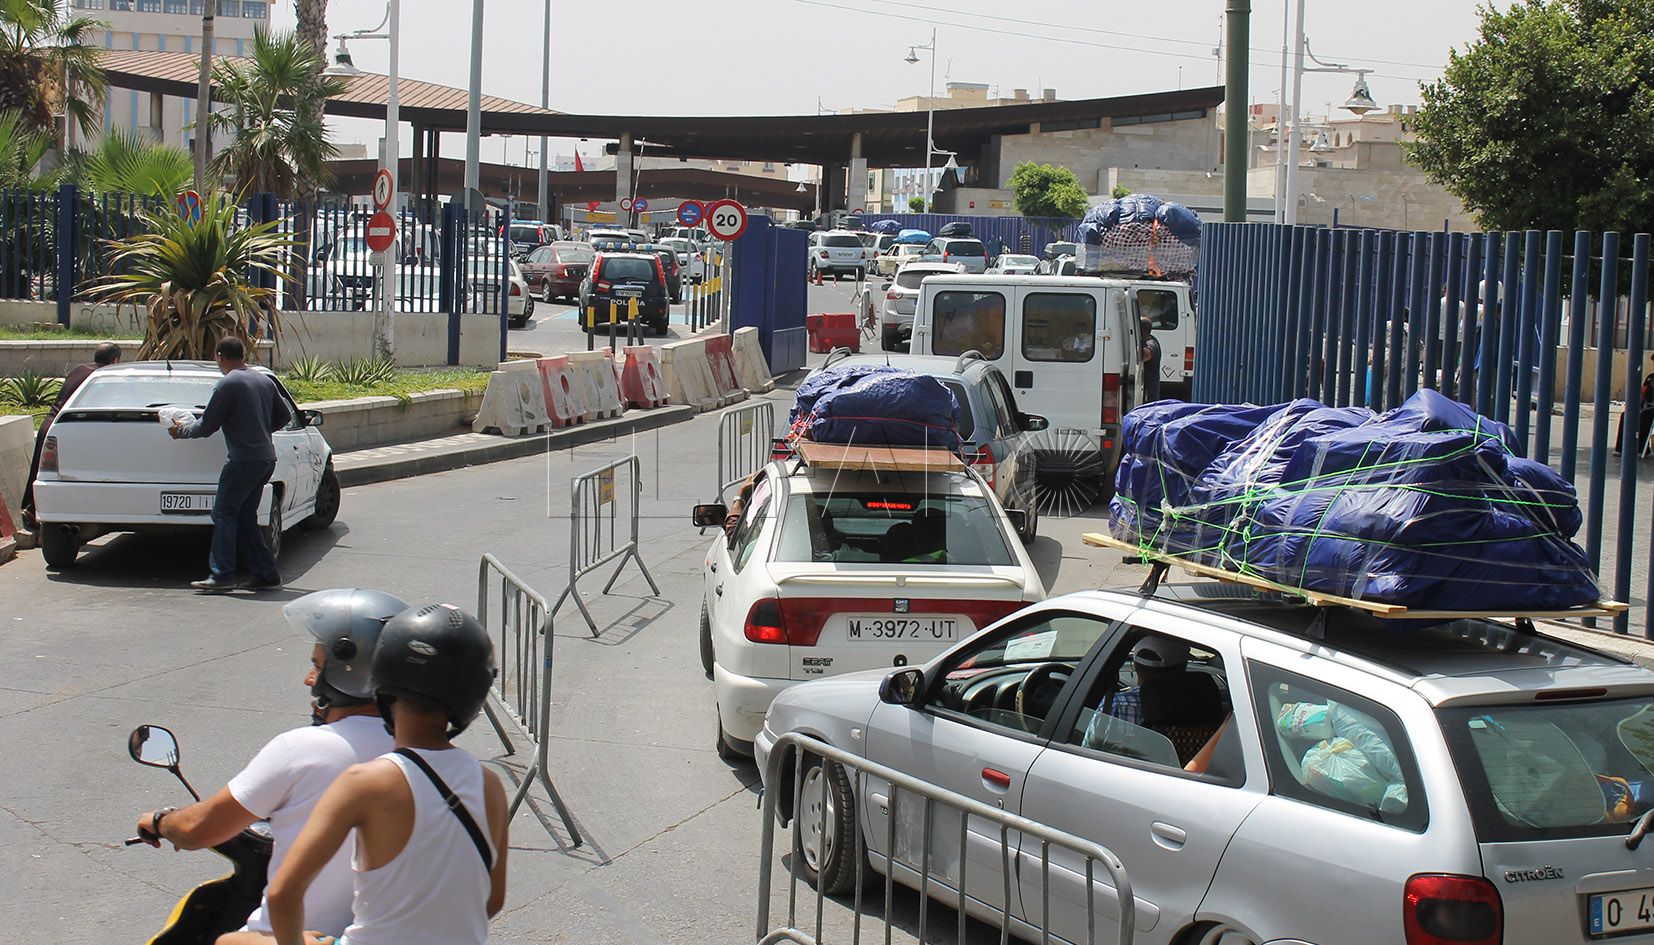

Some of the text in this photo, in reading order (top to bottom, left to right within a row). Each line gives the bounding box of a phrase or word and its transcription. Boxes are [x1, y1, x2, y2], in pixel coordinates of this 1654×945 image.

[716, 214, 737, 227] 20
[610, 298, 645, 306] POLIA
[162, 495, 192, 509] 19720
[802, 656, 834, 667] SEAT
[1505, 865, 1564, 883] CITROËN
